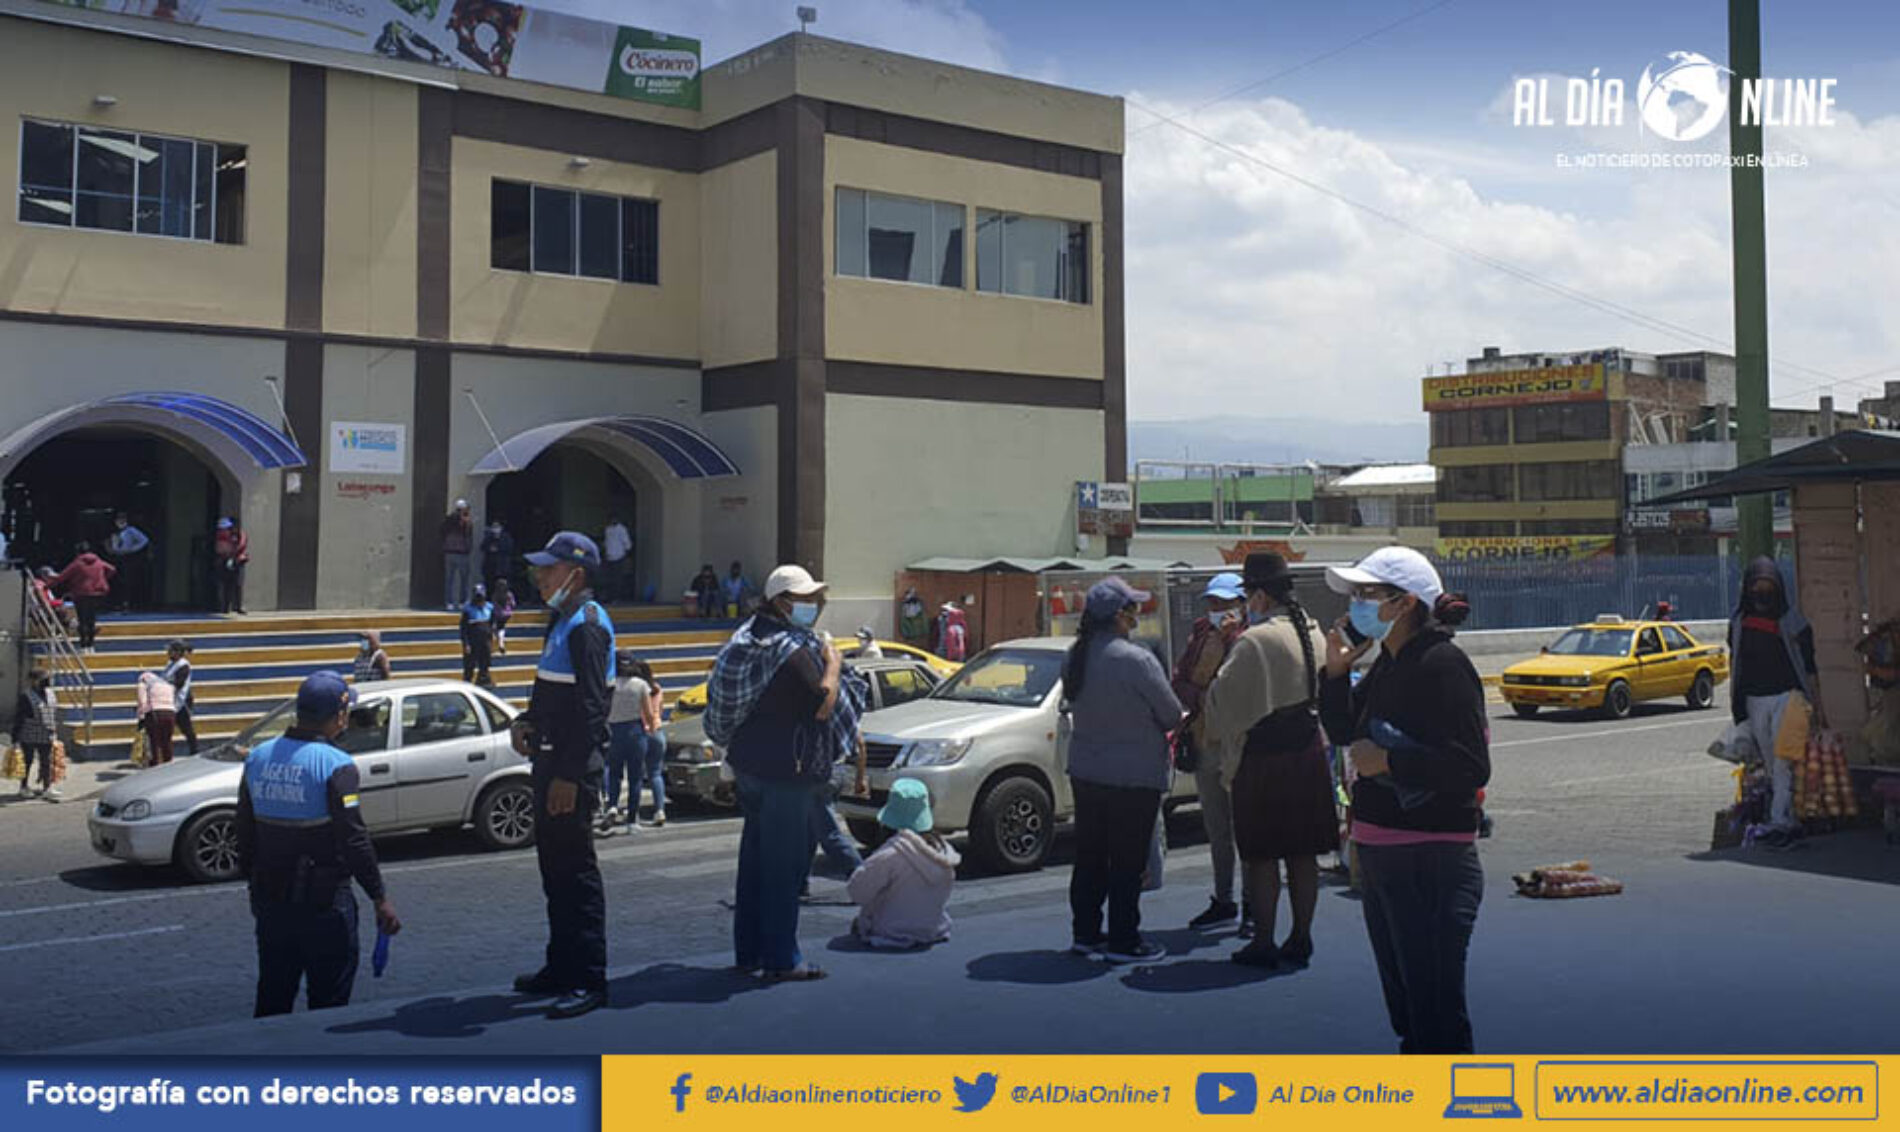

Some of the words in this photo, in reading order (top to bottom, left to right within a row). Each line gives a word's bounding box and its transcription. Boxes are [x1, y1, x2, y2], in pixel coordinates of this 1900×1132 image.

[626, 51, 697, 72] Cocinero
[1428, 365, 1594, 389] DISTRIBUCIONES
[1440, 379, 1572, 398] CORNEJO
[1443, 537, 1574, 547] DISTRIBUCIONES
[1451, 546, 1571, 561] CORNEJO
[261, 762, 304, 784] AGENTE
